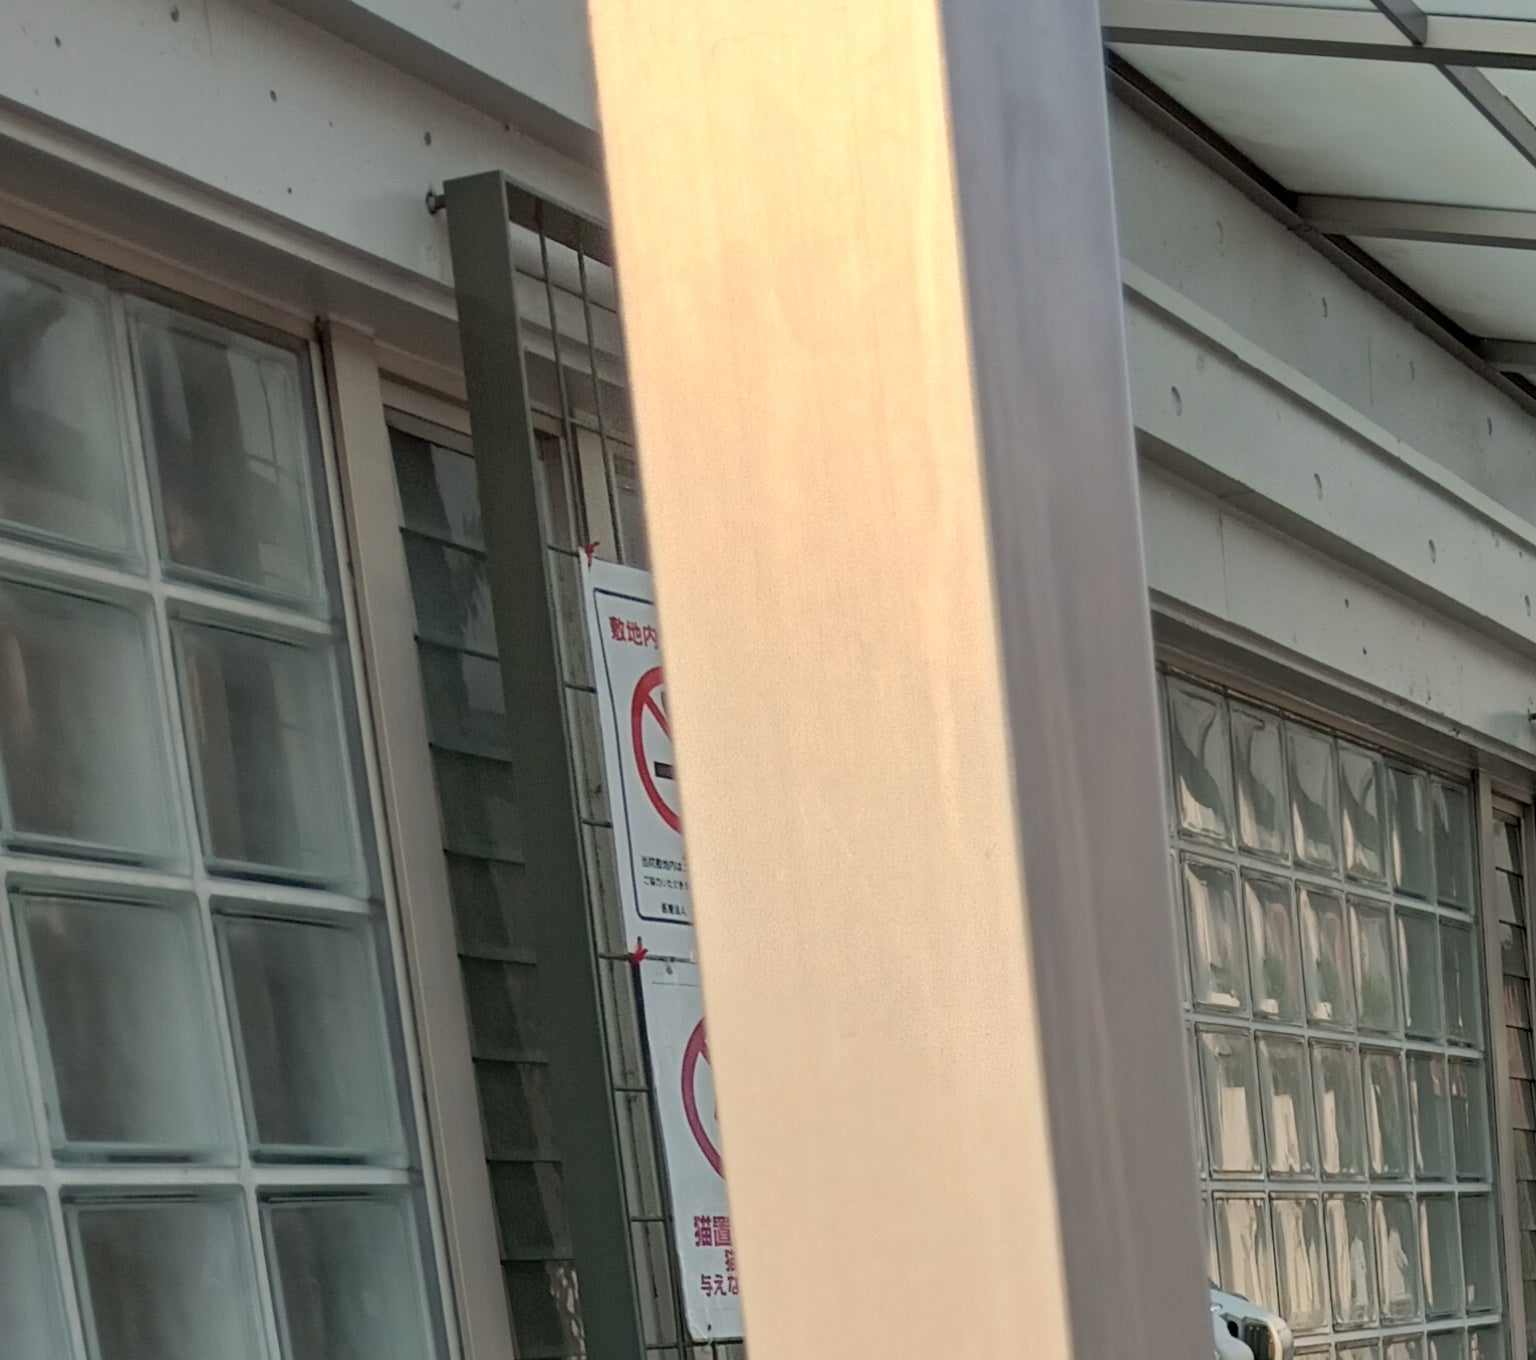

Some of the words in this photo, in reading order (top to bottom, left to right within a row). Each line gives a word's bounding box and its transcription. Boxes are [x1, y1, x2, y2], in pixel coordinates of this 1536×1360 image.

[609, 616, 658, 650] 敷地内
[701, 1273, 739, 1297] 与えな
